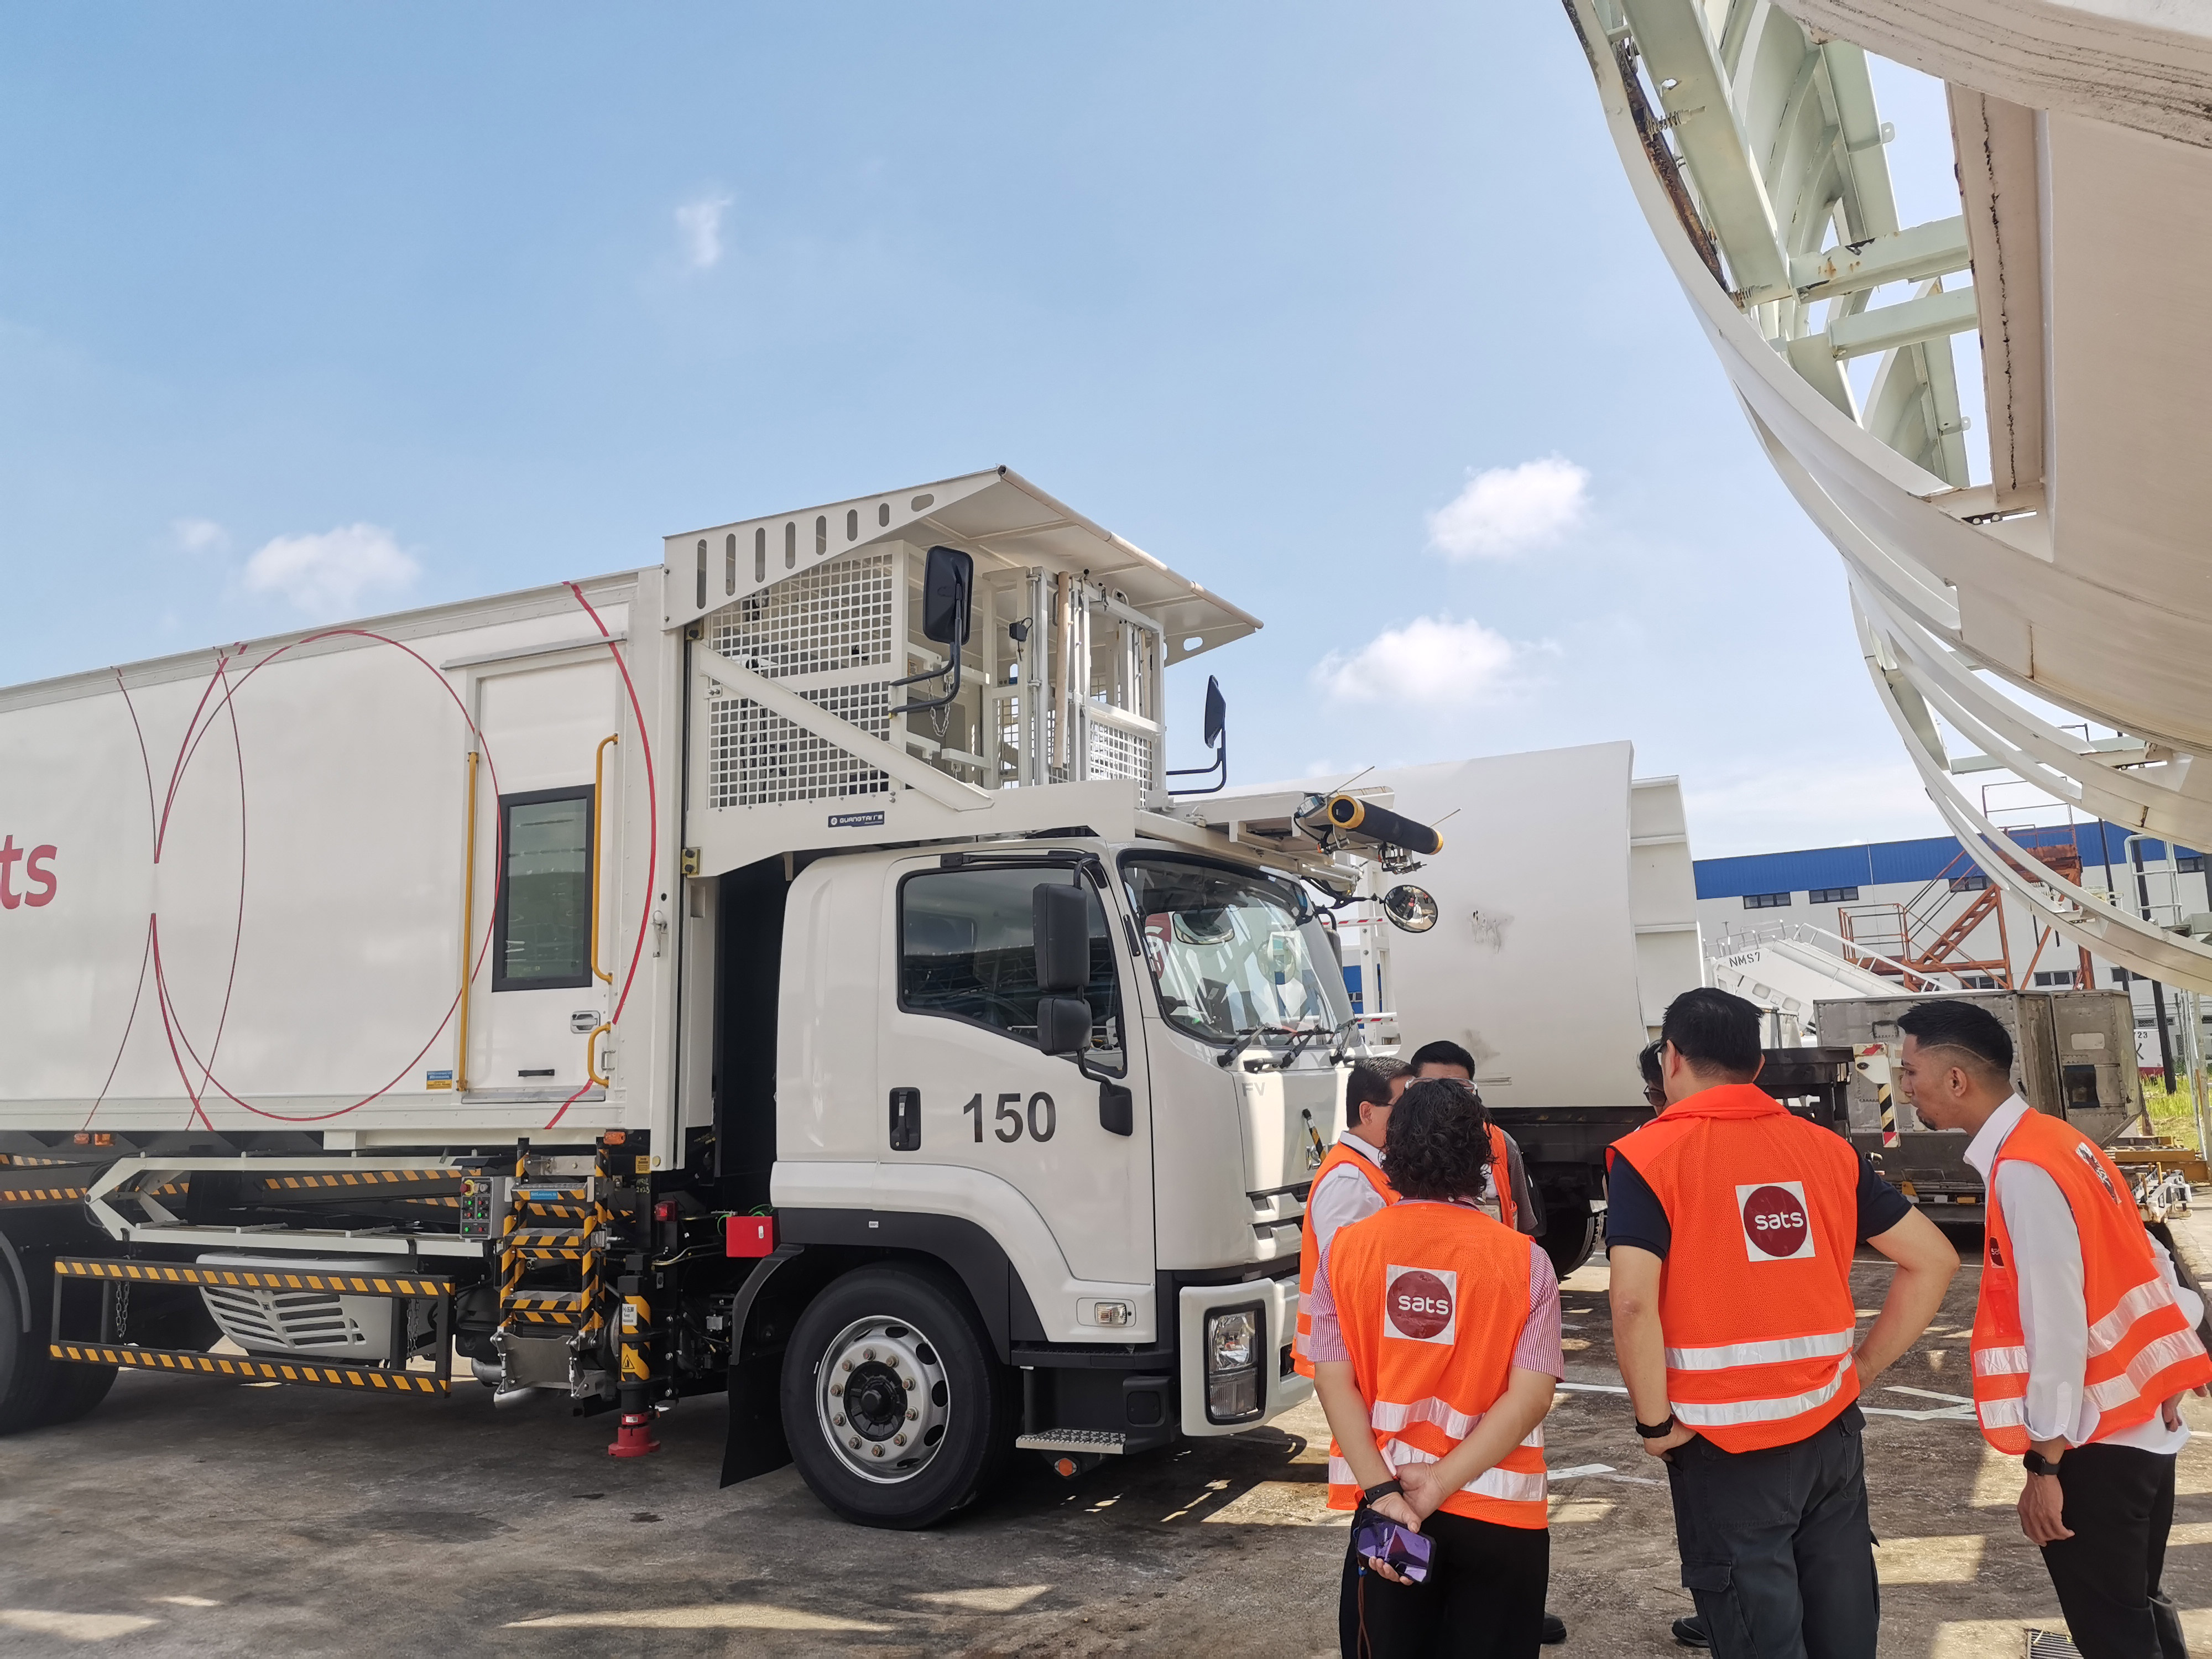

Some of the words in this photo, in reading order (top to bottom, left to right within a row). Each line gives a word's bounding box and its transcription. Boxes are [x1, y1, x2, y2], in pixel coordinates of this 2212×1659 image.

[0, 834, 58, 910] ts
[1241, 1082, 1265, 1097] FV
[963, 1091, 1056, 1143] 150
[1755, 1211, 1804, 1230] sats
[1398, 1295, 1449, 1315] sats
